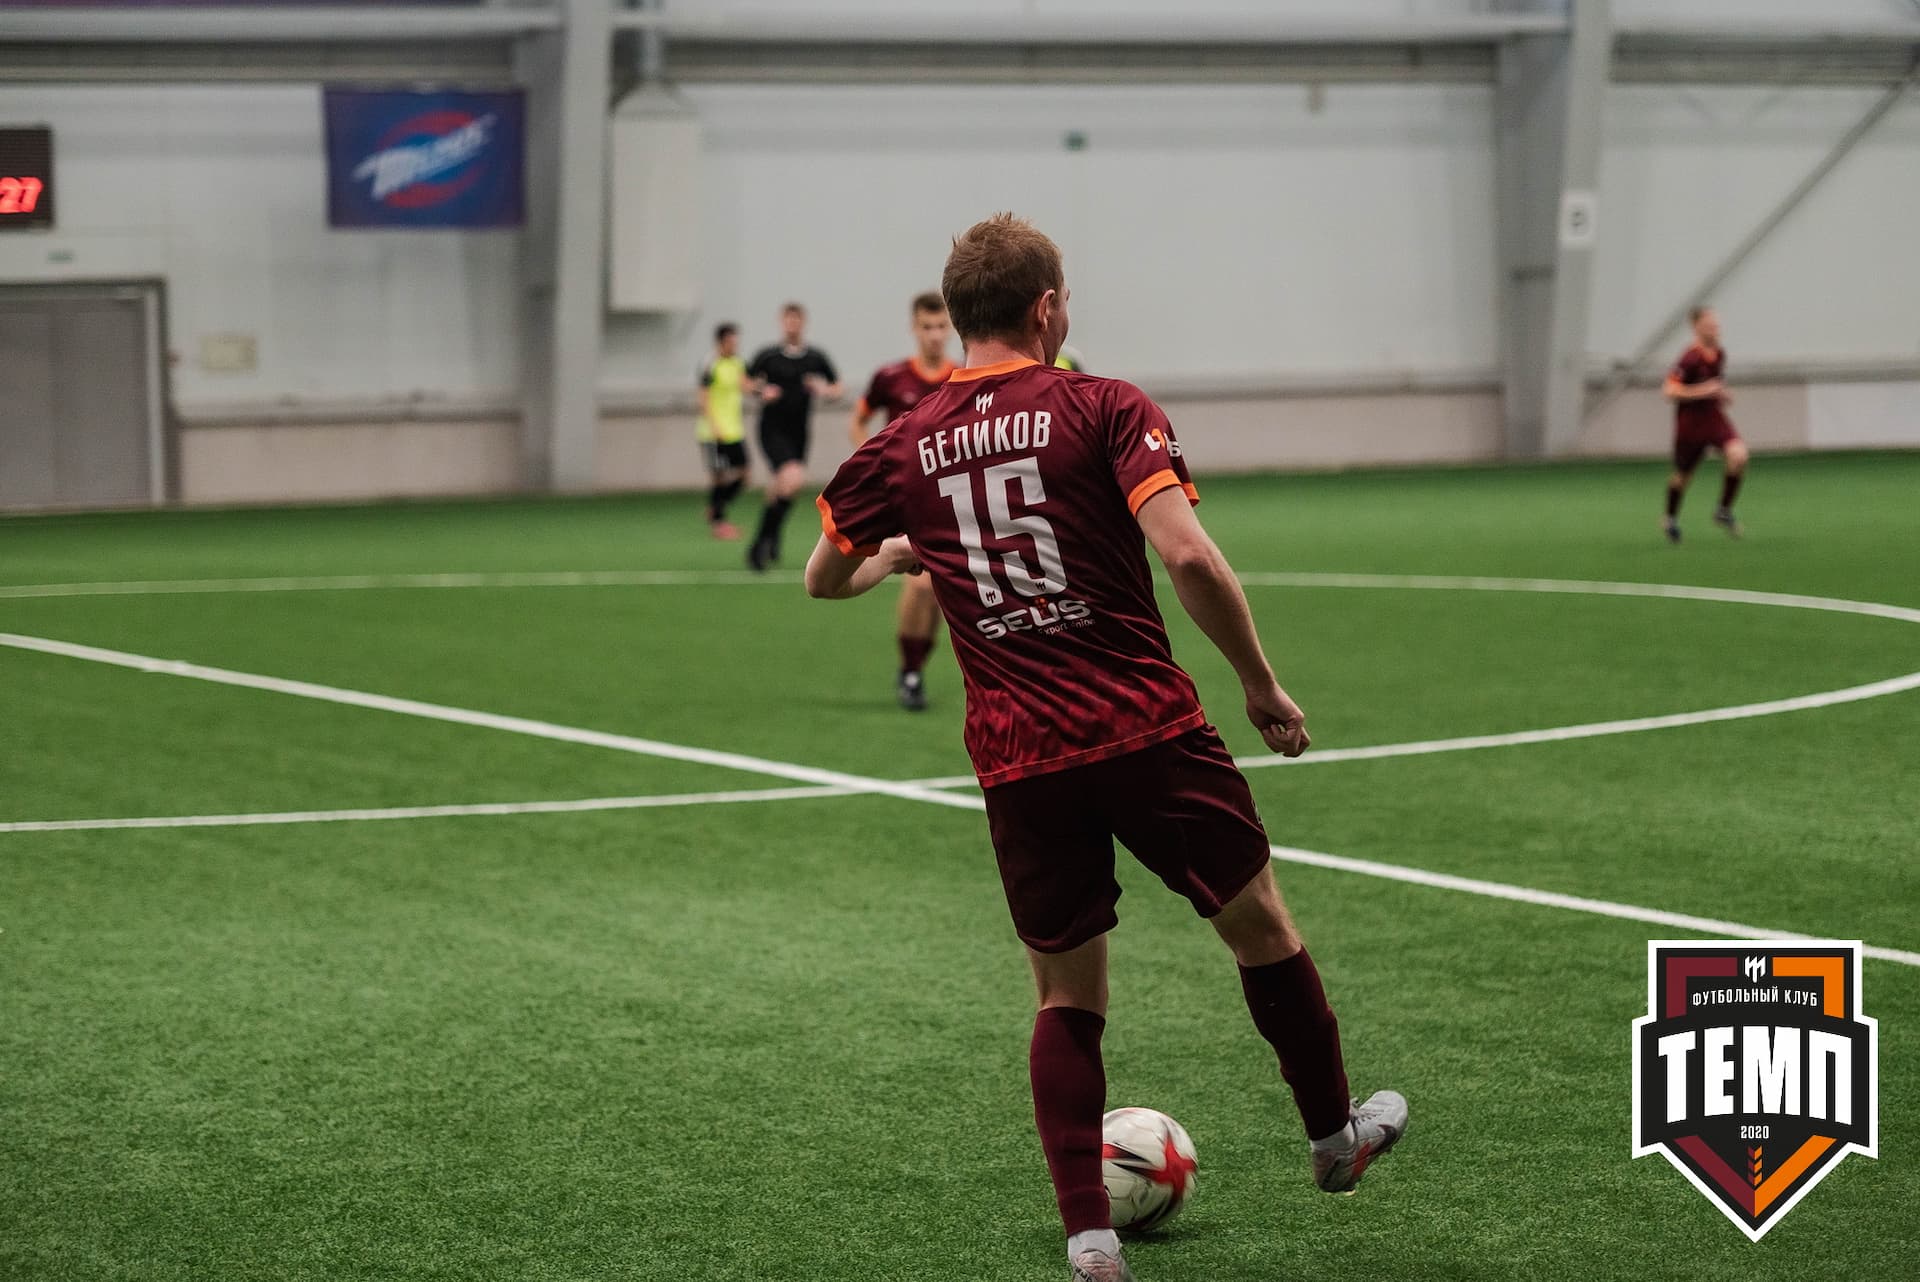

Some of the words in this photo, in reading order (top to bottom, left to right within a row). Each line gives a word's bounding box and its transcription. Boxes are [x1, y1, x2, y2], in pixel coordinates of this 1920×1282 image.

[918, 411, 1052, 476] БЕЛИКОВ
[938, 456, 1068, 608] 15
[976, 600, 1091, 639] SEUS
